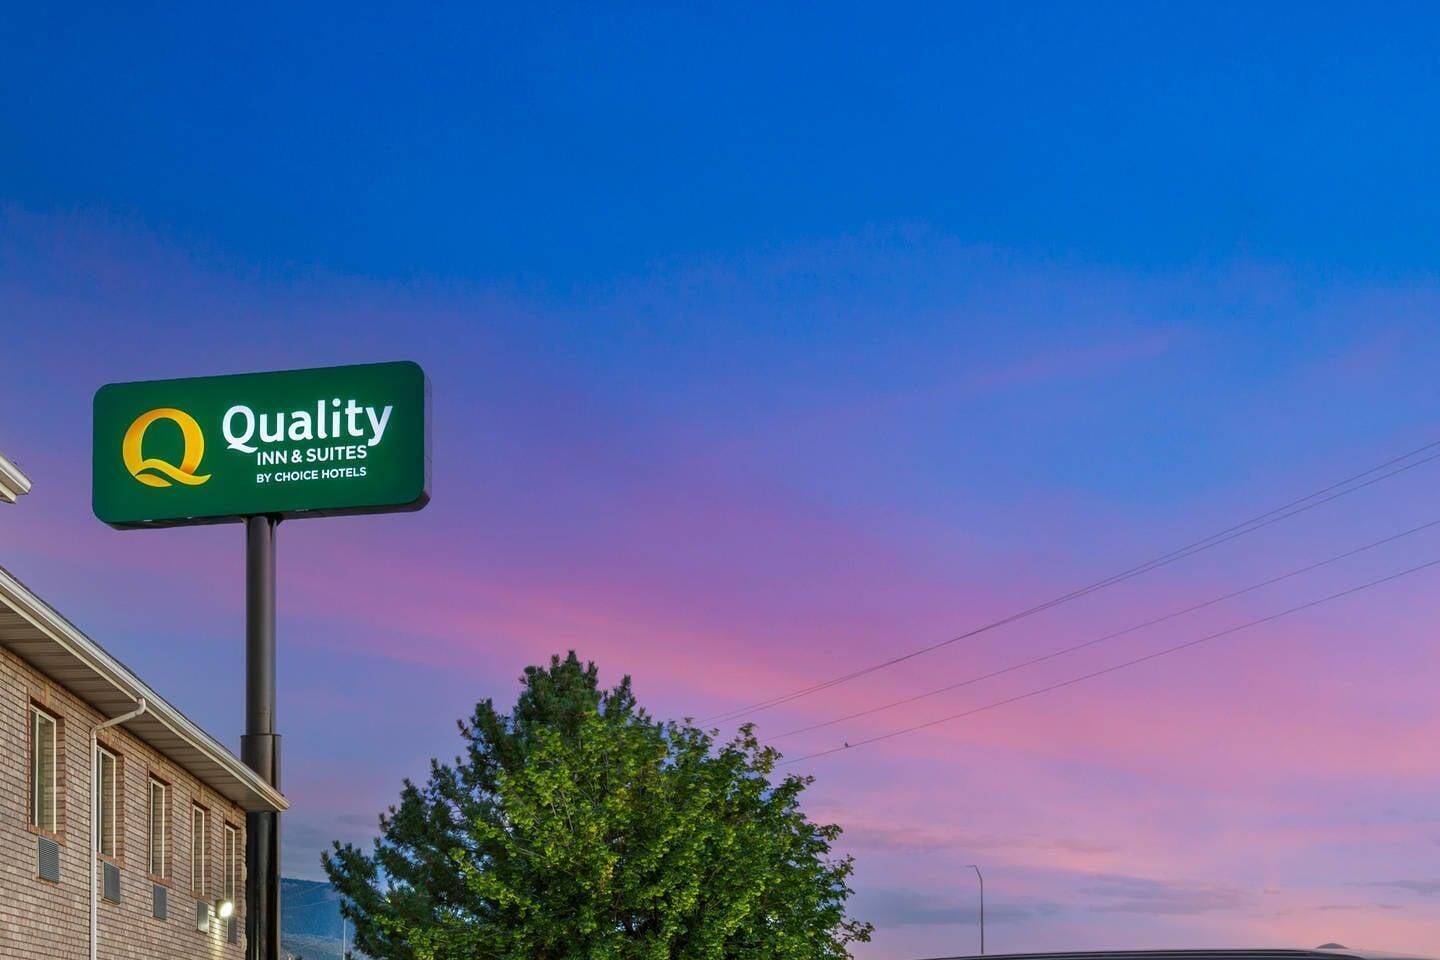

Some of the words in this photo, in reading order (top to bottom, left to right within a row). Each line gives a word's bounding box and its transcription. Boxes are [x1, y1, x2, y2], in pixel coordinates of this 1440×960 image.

[222, 398, 393, 453] Quality
[122, 408, 212, 487] Q
[257, 450, 288, 466] INN
[291, 449, 303, 464] &
[306, 444, 367, 462] SUITES
[256, 472, 272, 484] BY
[274, 469, 319, 482] CHOICE
[321, 466, 367, 479] HOTELS
